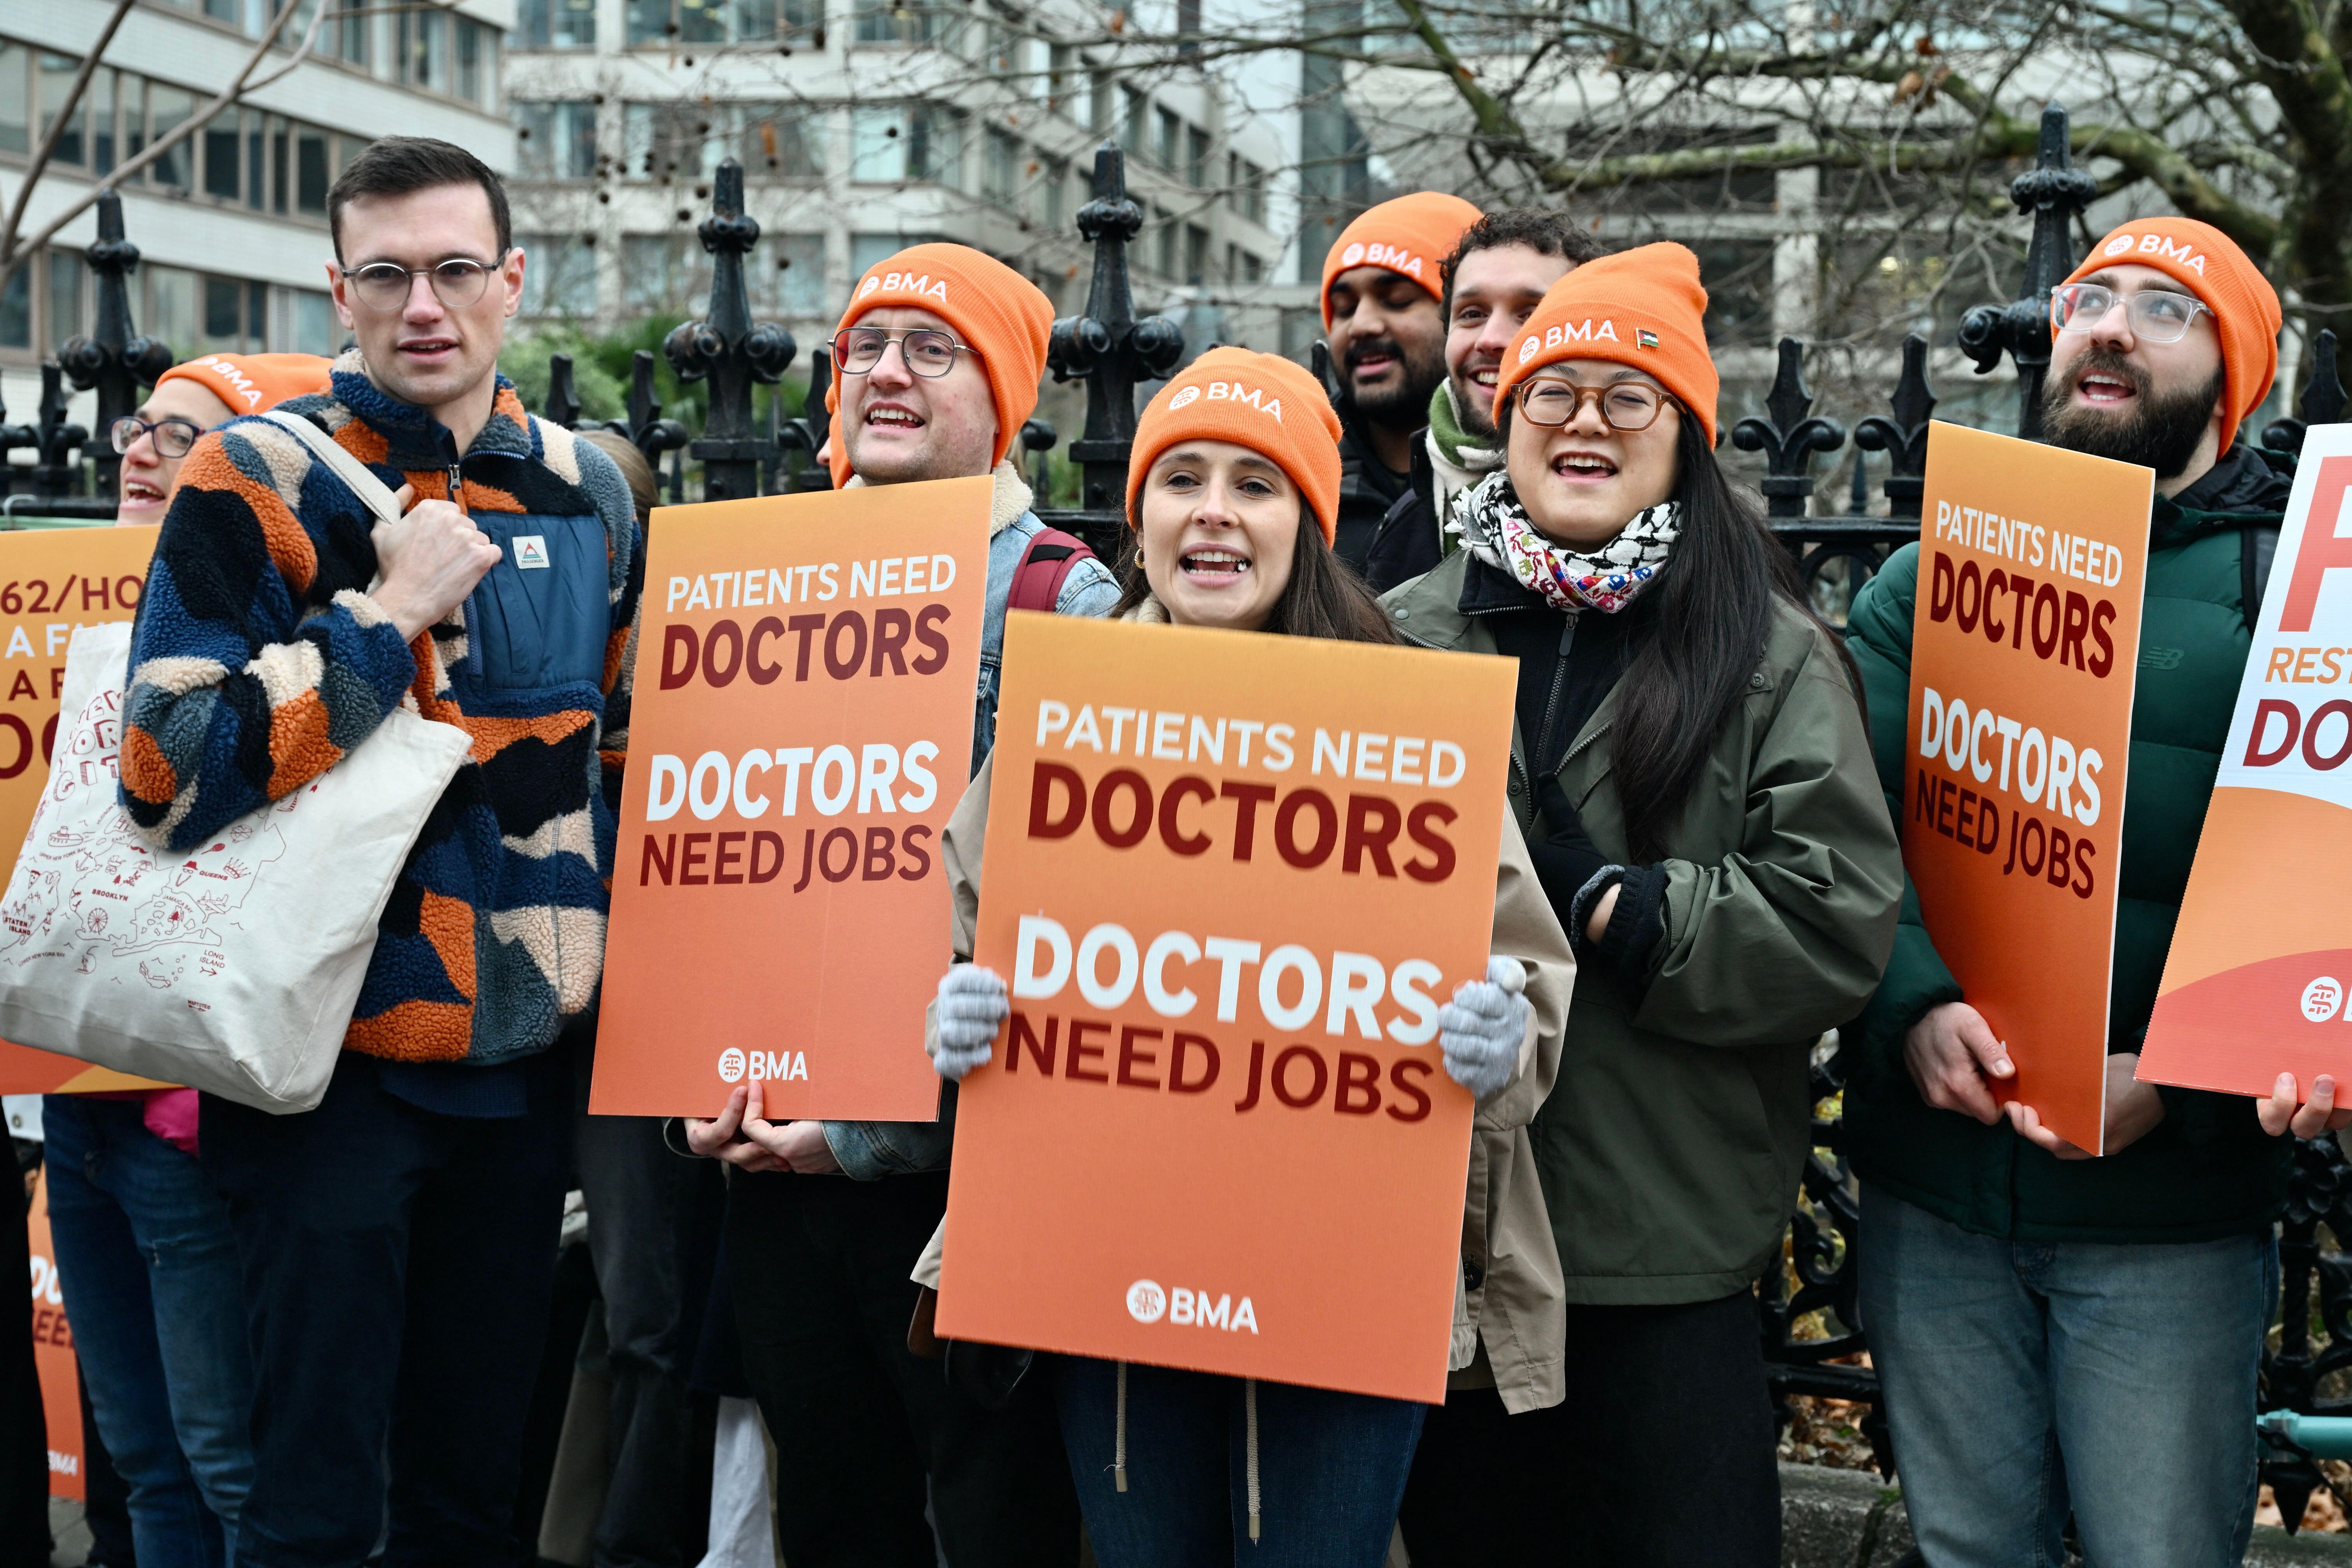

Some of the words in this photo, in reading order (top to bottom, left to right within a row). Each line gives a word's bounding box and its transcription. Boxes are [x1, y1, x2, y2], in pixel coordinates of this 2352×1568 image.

[1367, 243, 1422, 277] BMA
[2138, 234, 2205, 276] BMA
[882, 272, 946, 302] BMA
[1546, 319, 1619, 348] BMA
[211, 361, 262, 407] BMA
[1207, 382, 1281, 423] BMA
[1936, 500, 2045, 567] PATIENTS
[2050, 531, 2122, 587] NEED
[667, 563, 840, 612] PATIENTS
[850, 554, 956, 598] NEED
[1930, 551, 2116, 678] DOCTORS
[5, 625, 35, 659] A
[660, 604, 951, 690] DOCTORS
[9, 669, 38, 701] A
[2265, 647, 2352, 684] RES
[1036, 699, 1295, 772] PATIENTS
[1311, 728, 1466, 788] NEED
[1920, 687, 2103, 826] DOCTORS
[646, 740, 940, 821] DOCTORS
[1027, 758, 1459, 886] DOCTORS
[1916, 769, 1999, 855] NEED
[2004, 810, 2096, 899] JOBS
[199, 870, 228, 880] QUEENS
[640, 830, 784, 886] NEED
[794, 824, 933, 893] JOBS
[92, 889, 128, 901] BROOKLYN
[162, 895, 184, 906] JAMAICA
[4, 917, 28, 928] STATEN
[9, 926, 30, 935] ISLAND
[200, 957, 225, 968] ISLAND
[204, 950, 224, 960] LONG
[1013, 914, 1443, 1046] DOCTORS
[748, 1051, 808, 1080] BMA
[1005, 1012, 1221, 1094] NEED
[1235, 1040, 1434, 1123] JOBS
[1170, 1286, 1259, 1335] BMA
